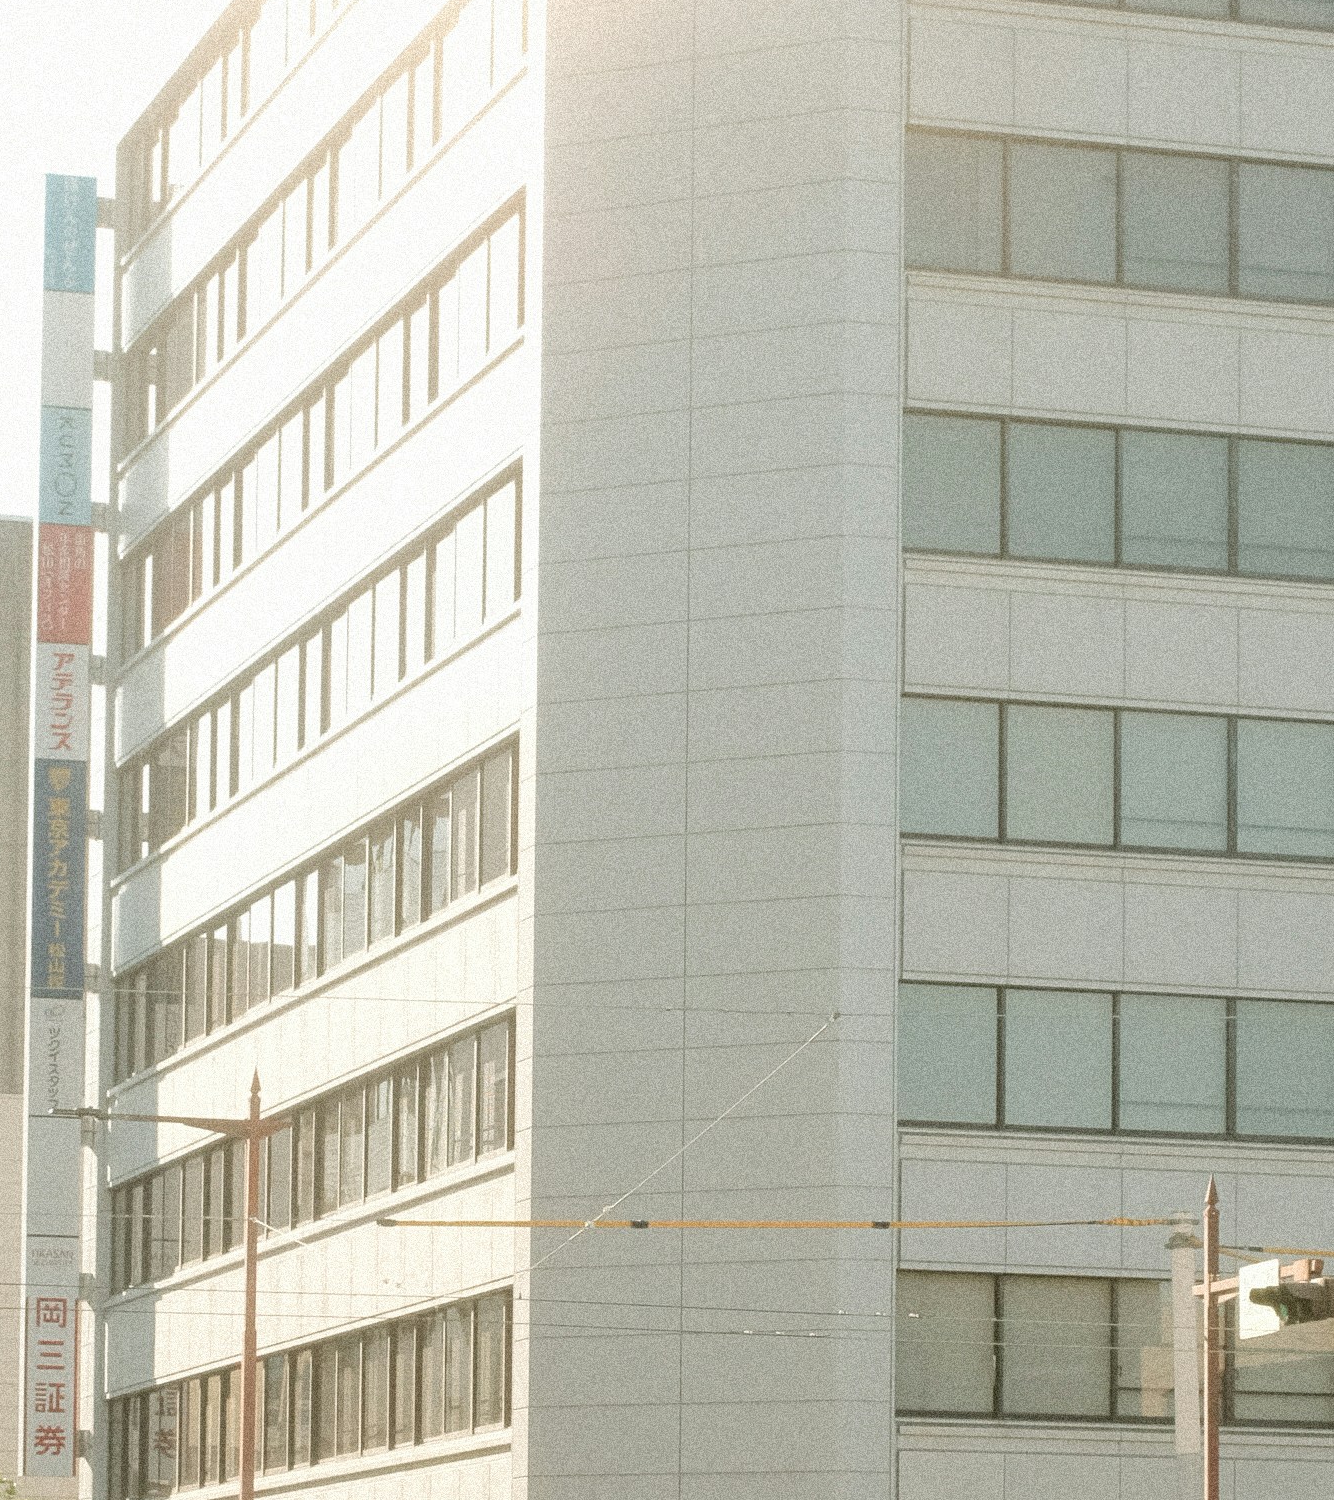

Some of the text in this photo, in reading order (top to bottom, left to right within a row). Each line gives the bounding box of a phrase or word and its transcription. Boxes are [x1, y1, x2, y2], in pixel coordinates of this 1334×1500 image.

[56, 416, 77, 517] KUMON
[48, 651, 75, 752] アデランス
[47, 797, 72, 938] 東京アカデミー
[33, 1297, 69, 1457] 岡三証券
